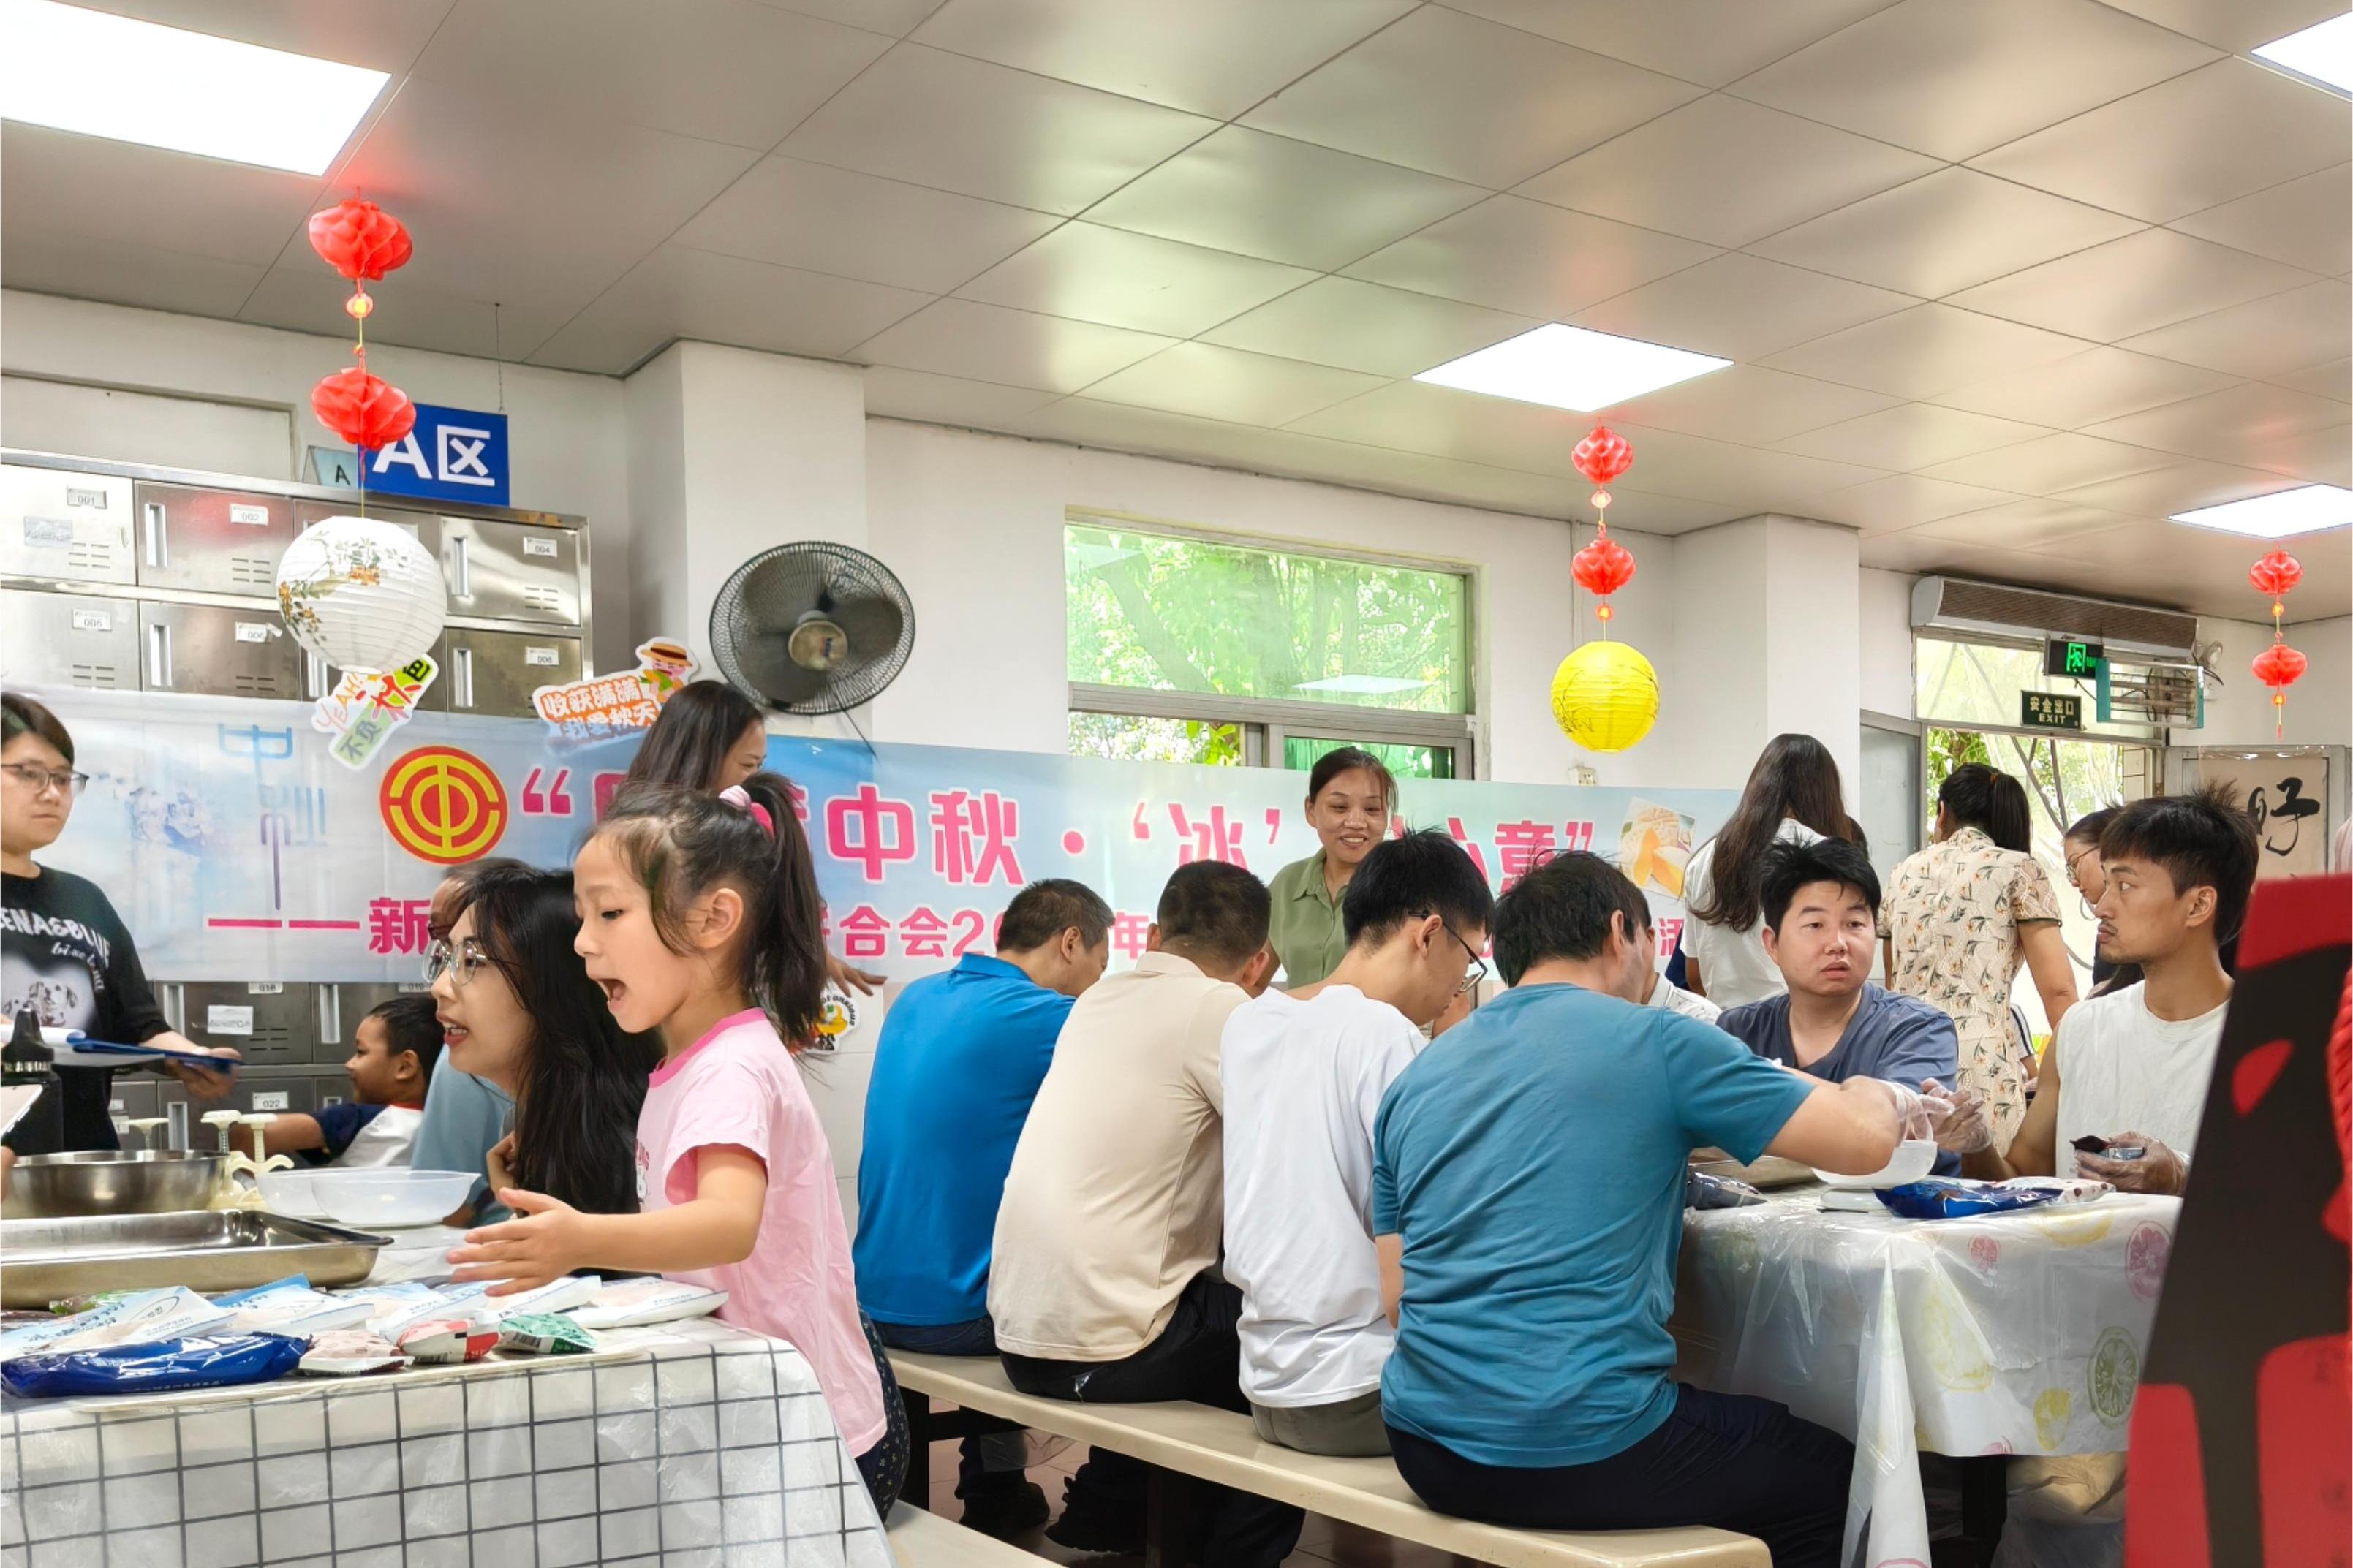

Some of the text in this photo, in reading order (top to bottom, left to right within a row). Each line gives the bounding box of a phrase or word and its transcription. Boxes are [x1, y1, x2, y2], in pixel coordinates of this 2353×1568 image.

[2029, 695, 2074, 716] 安全出口
[2039, 713, 2066, 724] EXIT
